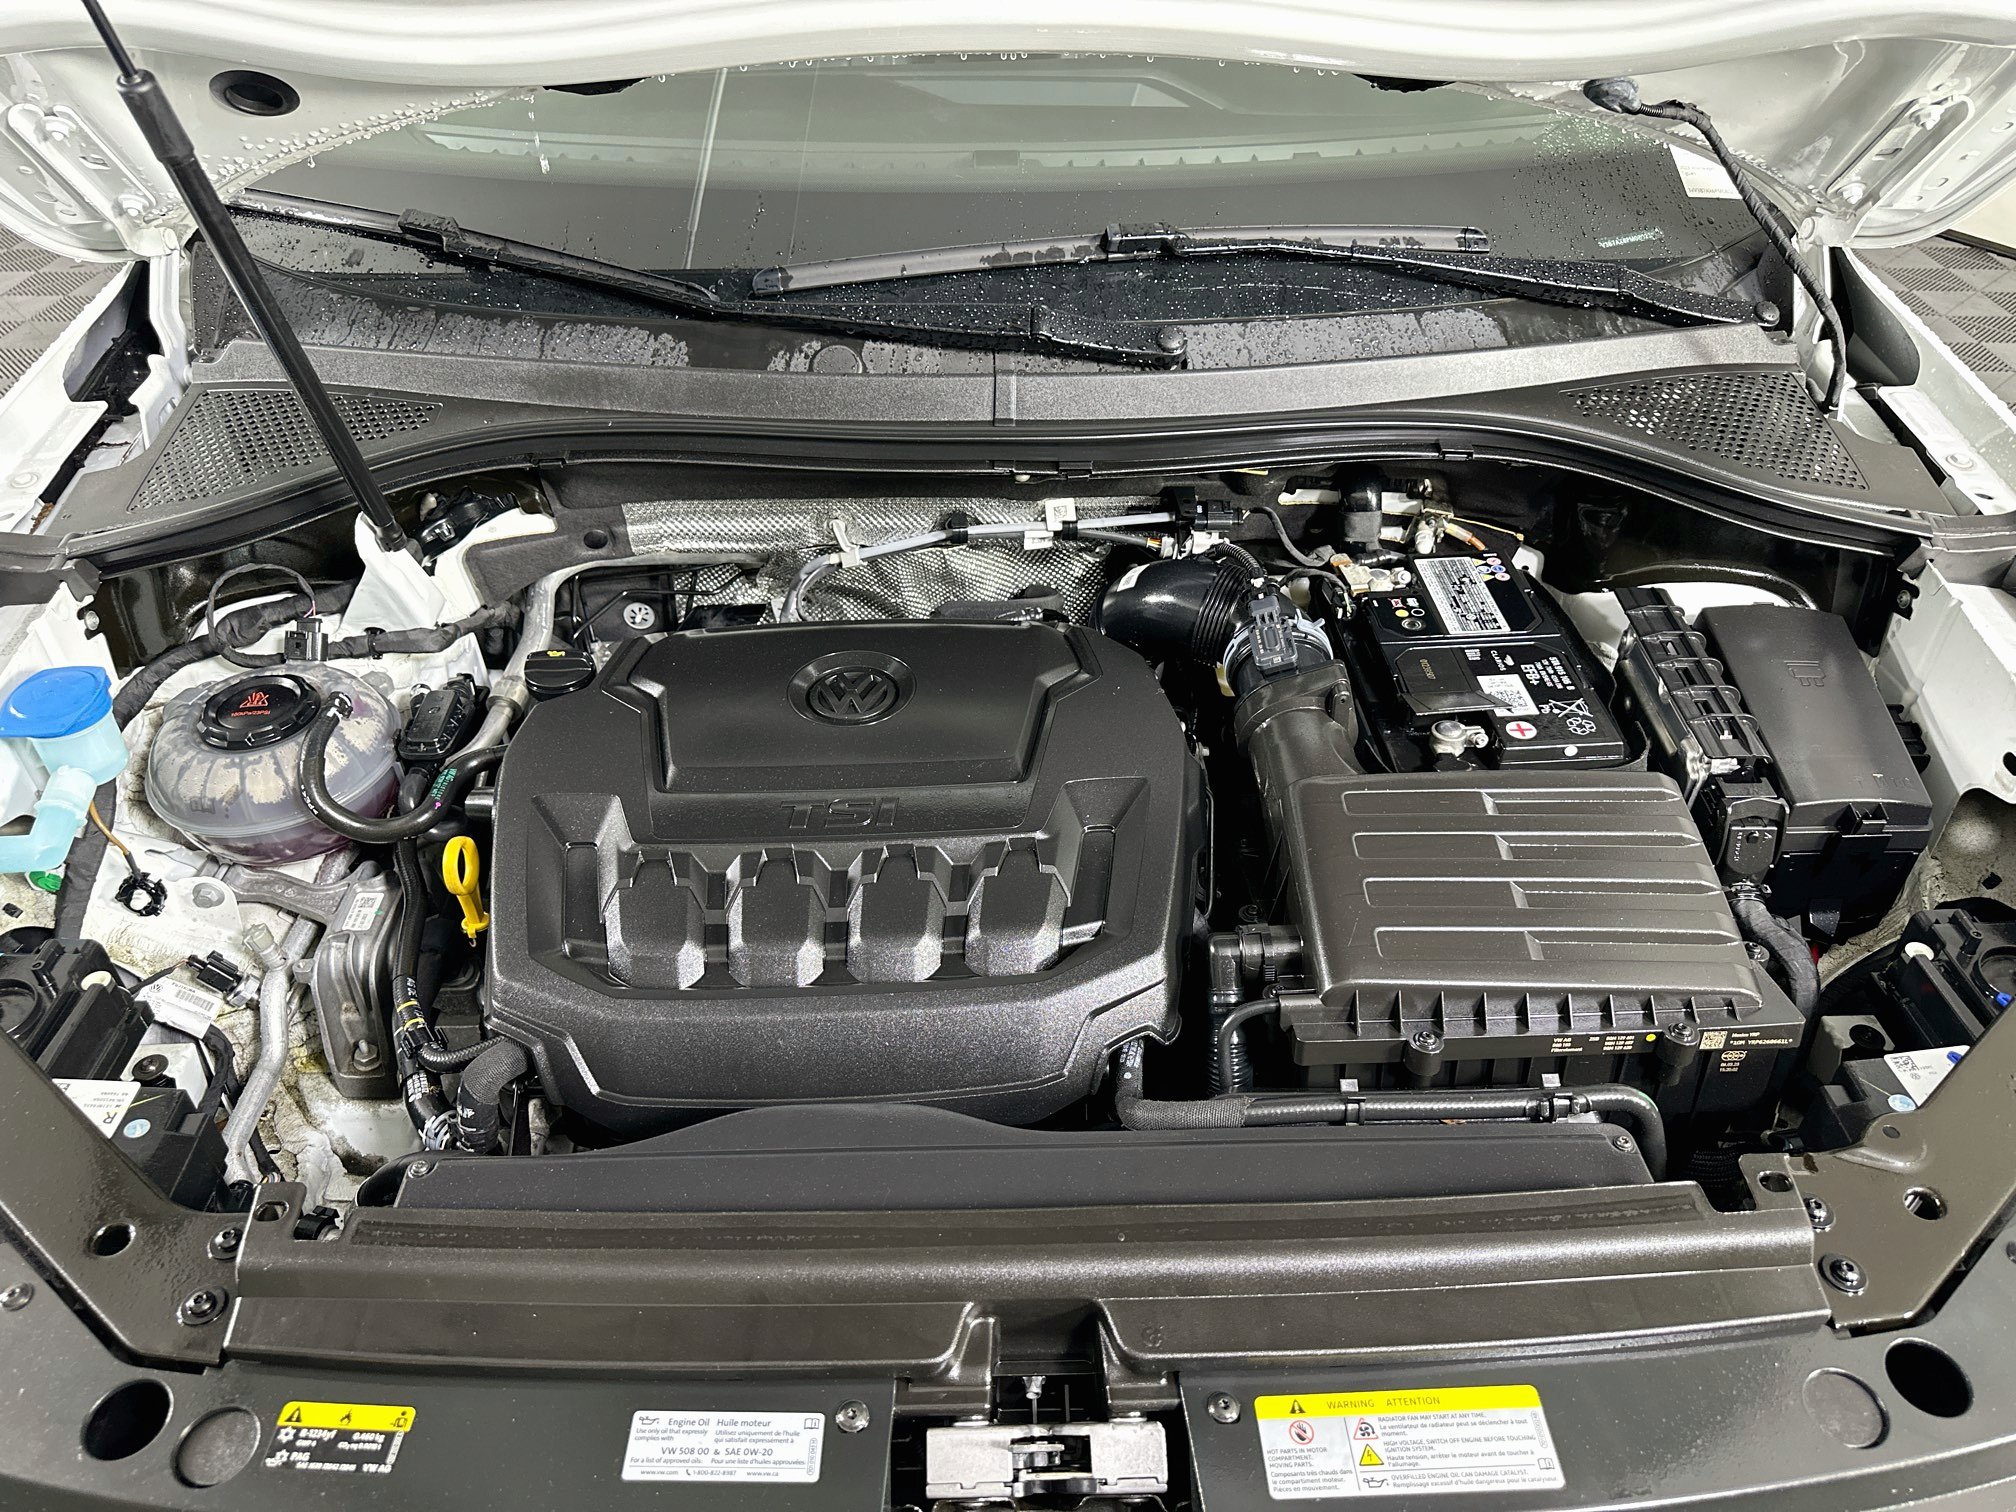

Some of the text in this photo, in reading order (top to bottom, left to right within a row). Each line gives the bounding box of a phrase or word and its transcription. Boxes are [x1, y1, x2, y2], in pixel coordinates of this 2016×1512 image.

[1490, 650, 1506, 671] CLARIOS
[1520, 664, 1540, 686] EFB+
[1538, 704, 1551, 714] Pb
[780, 798, 900, 828] TSI
[103, 1112, 117, 1124] R
[1327, 1397, 1440, 1409] WARNING ATTENTION
[668, 1418, 710, 1427] Engine Oil
[717, 1418, 738, 1426] Huile
[289, 1452, 311, 1461] PAG
